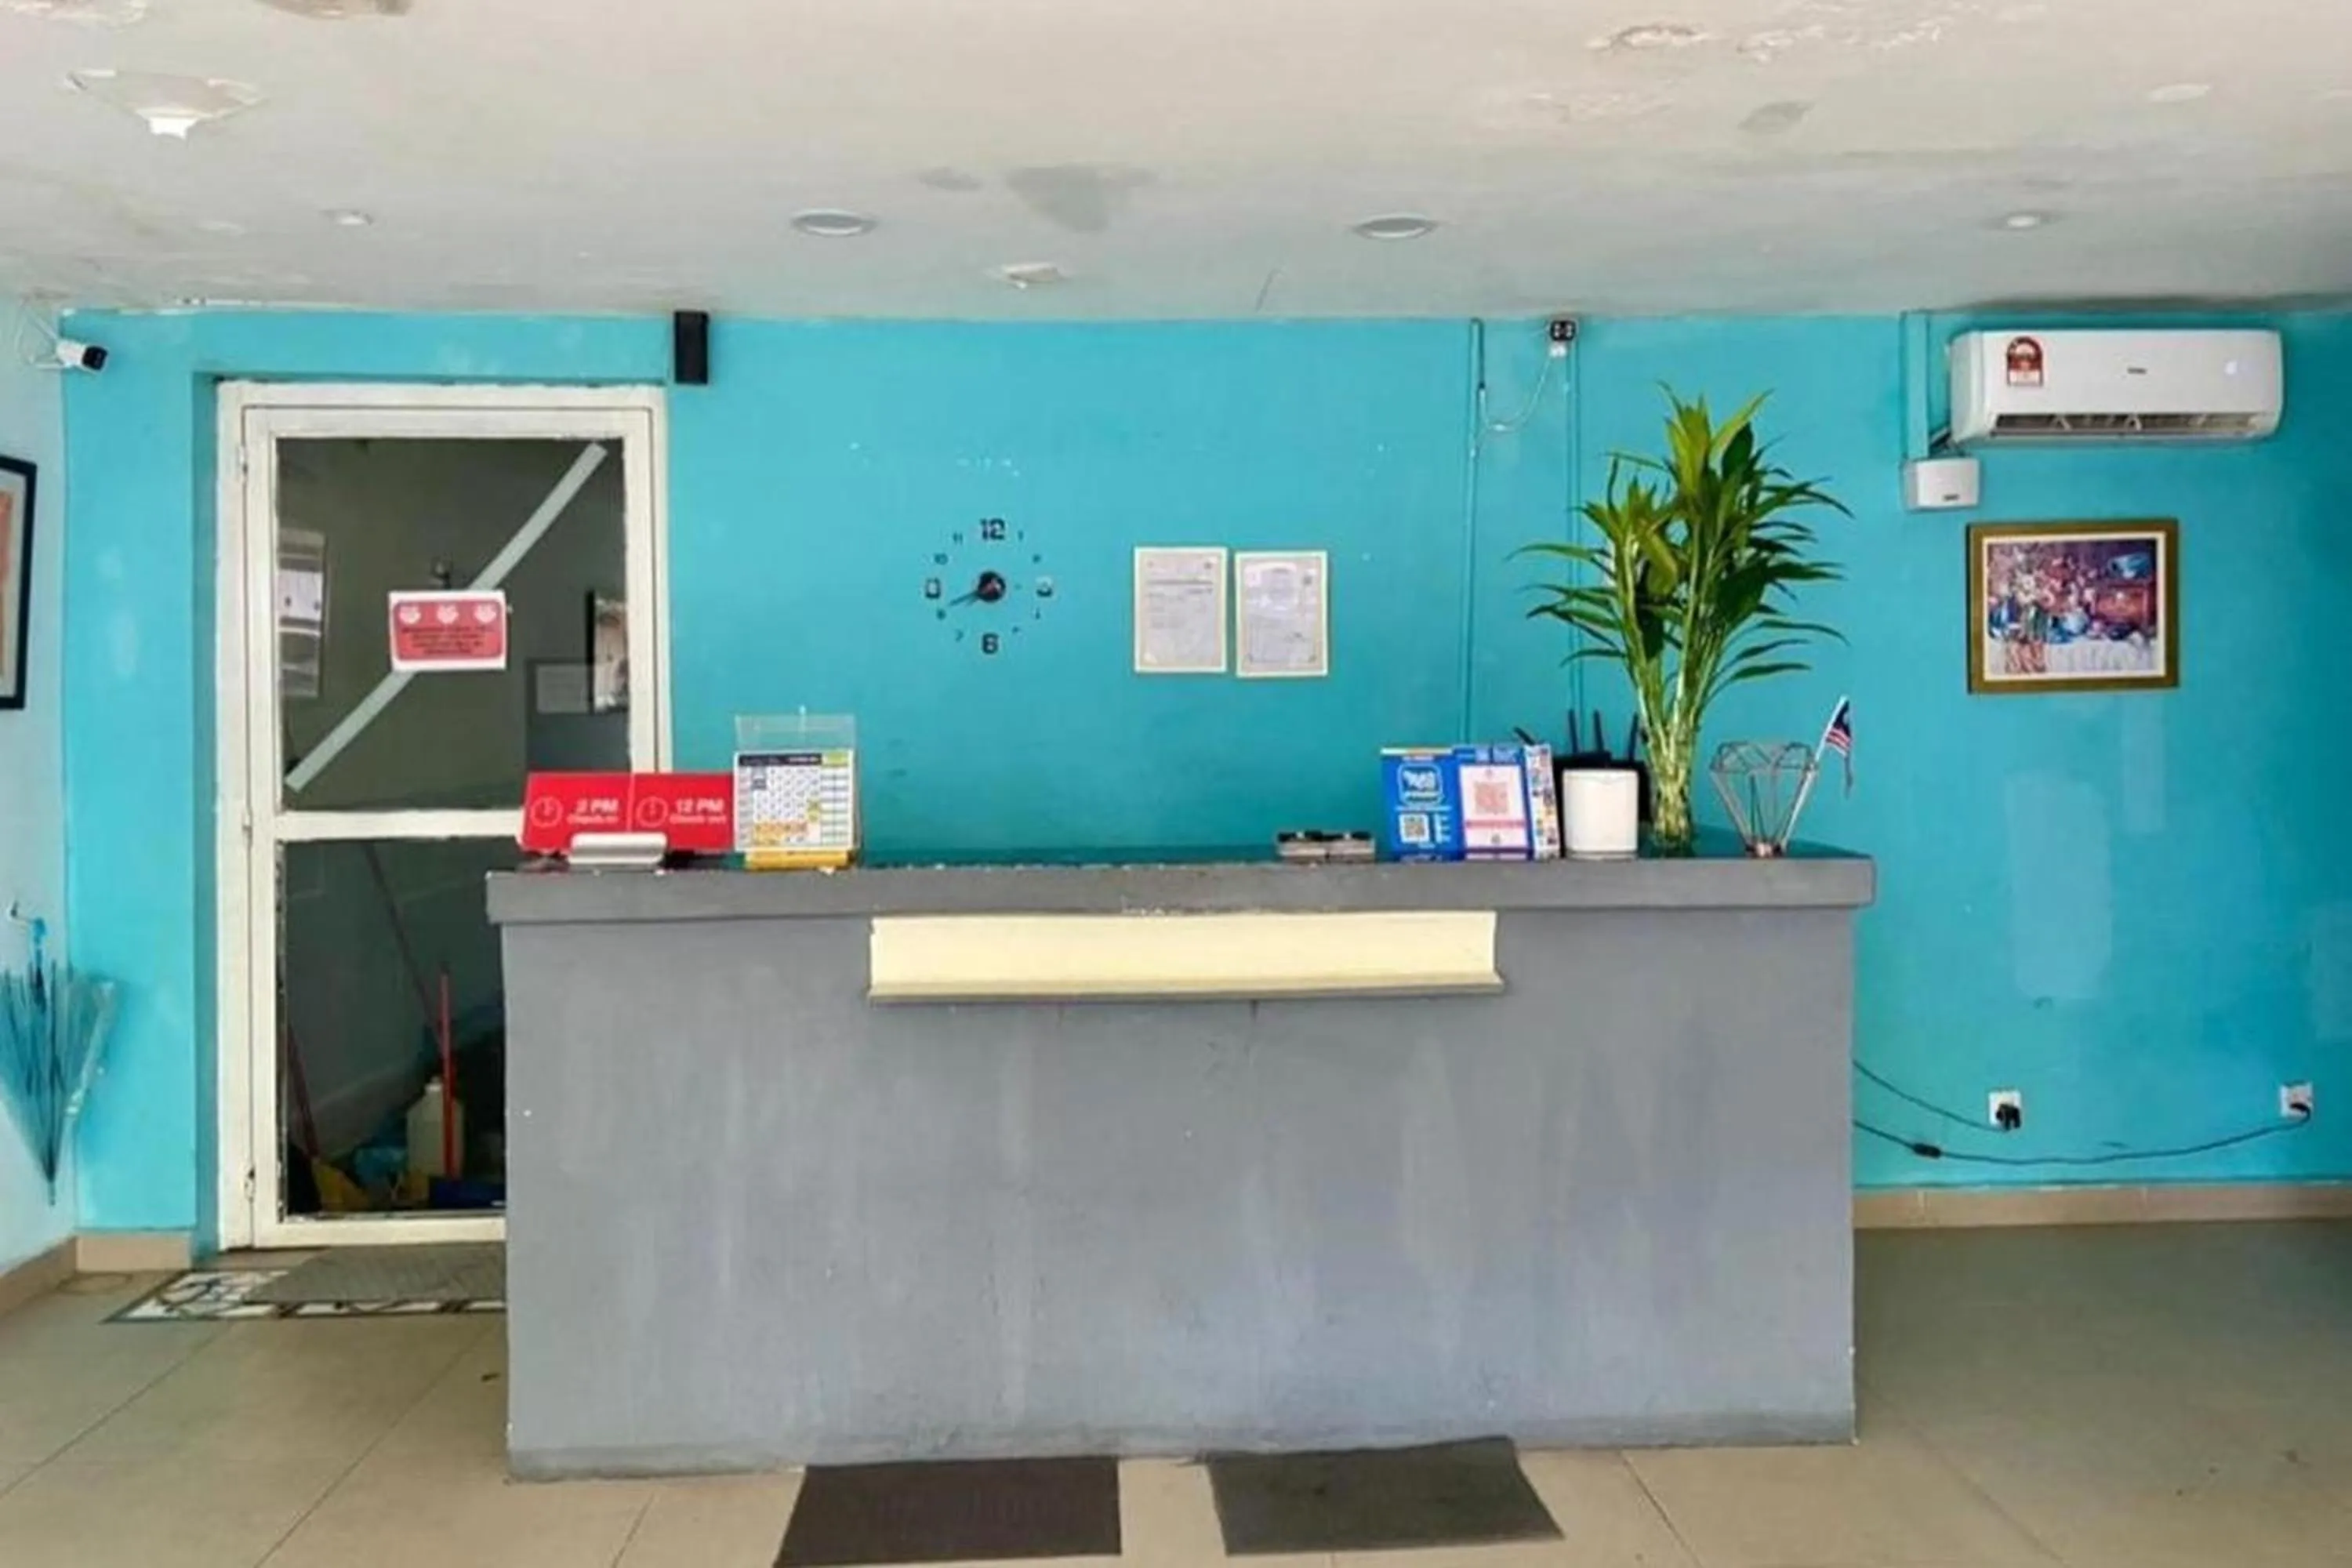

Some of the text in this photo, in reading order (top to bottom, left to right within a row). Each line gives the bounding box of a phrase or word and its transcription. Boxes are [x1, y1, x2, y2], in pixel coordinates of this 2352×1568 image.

[980, 518, 1005, 540] 12
[982, 633, 1000, 655] 6
[590, 798, 619, 812] PM
[676, 798, 724, 813] 12 PM
